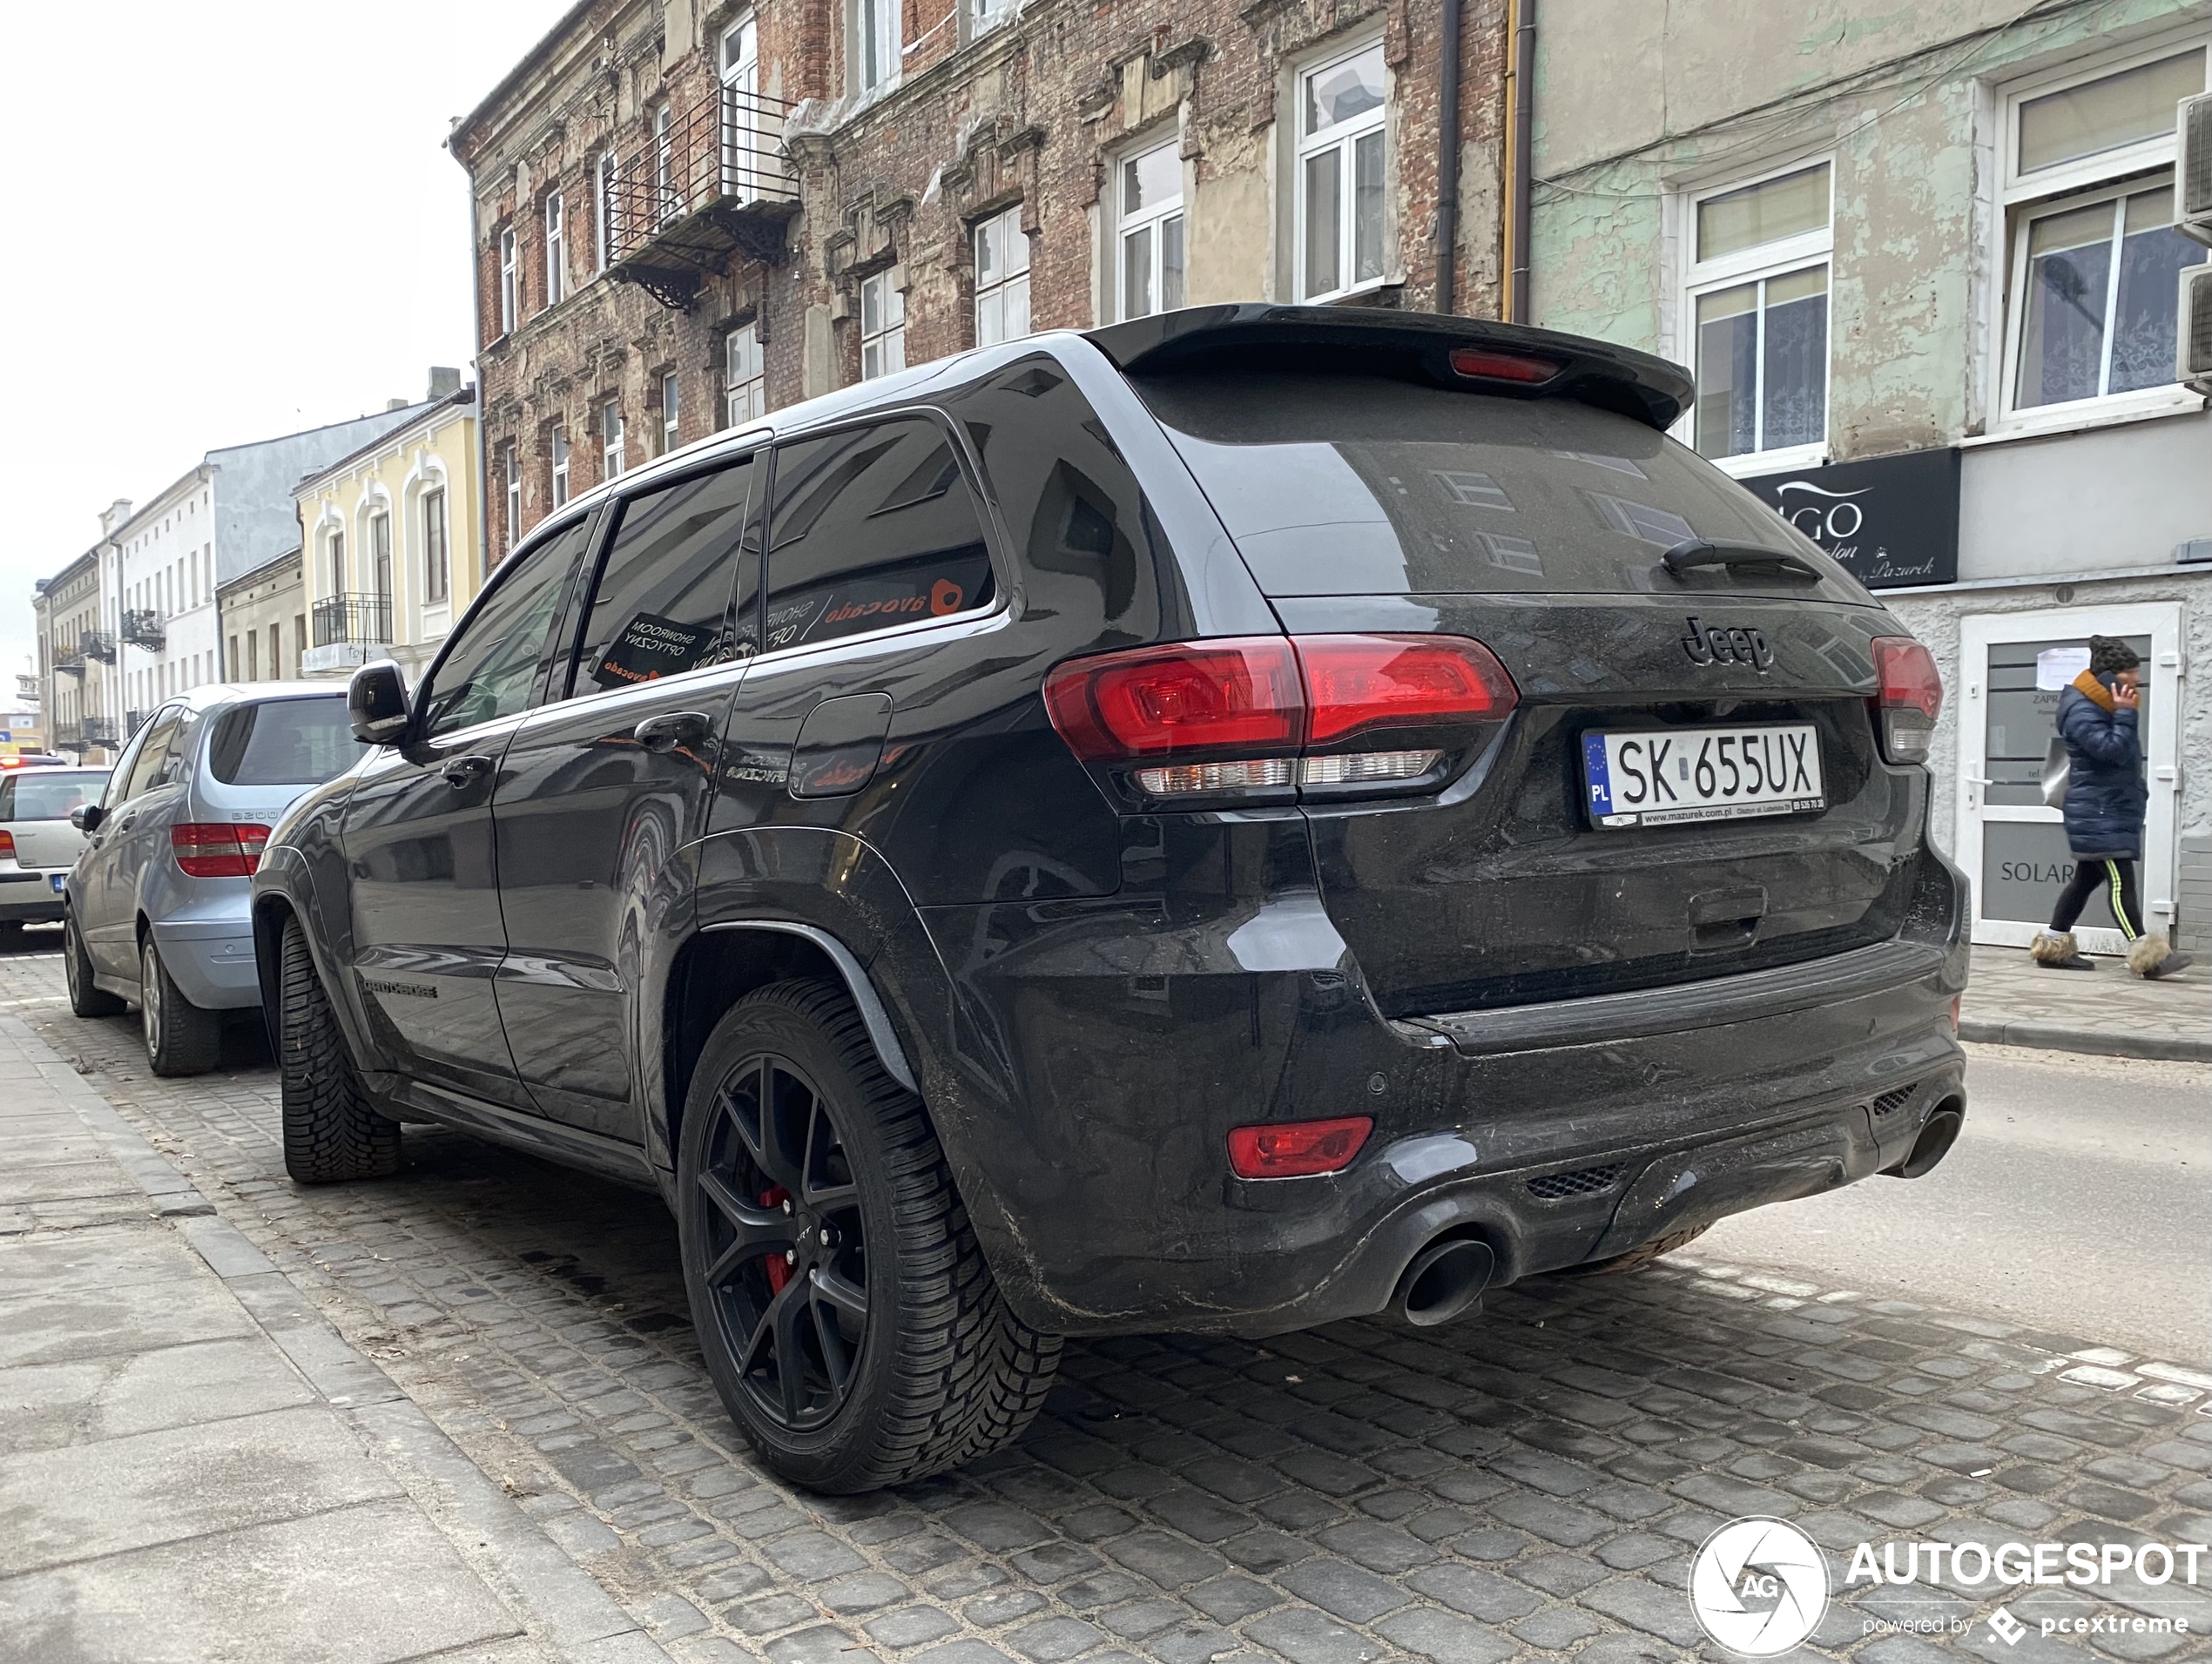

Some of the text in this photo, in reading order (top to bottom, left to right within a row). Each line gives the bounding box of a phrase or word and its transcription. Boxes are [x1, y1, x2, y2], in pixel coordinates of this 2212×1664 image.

[1680, 616, 1774, 675] Jeep
[1619, 733, 1811, 803] SK 655UX
[1591, 785, 1608, 802] PL
[232, 811, 279, 820] B200
[1644, 807, 1732, 824] www.mazurek.com.pl
